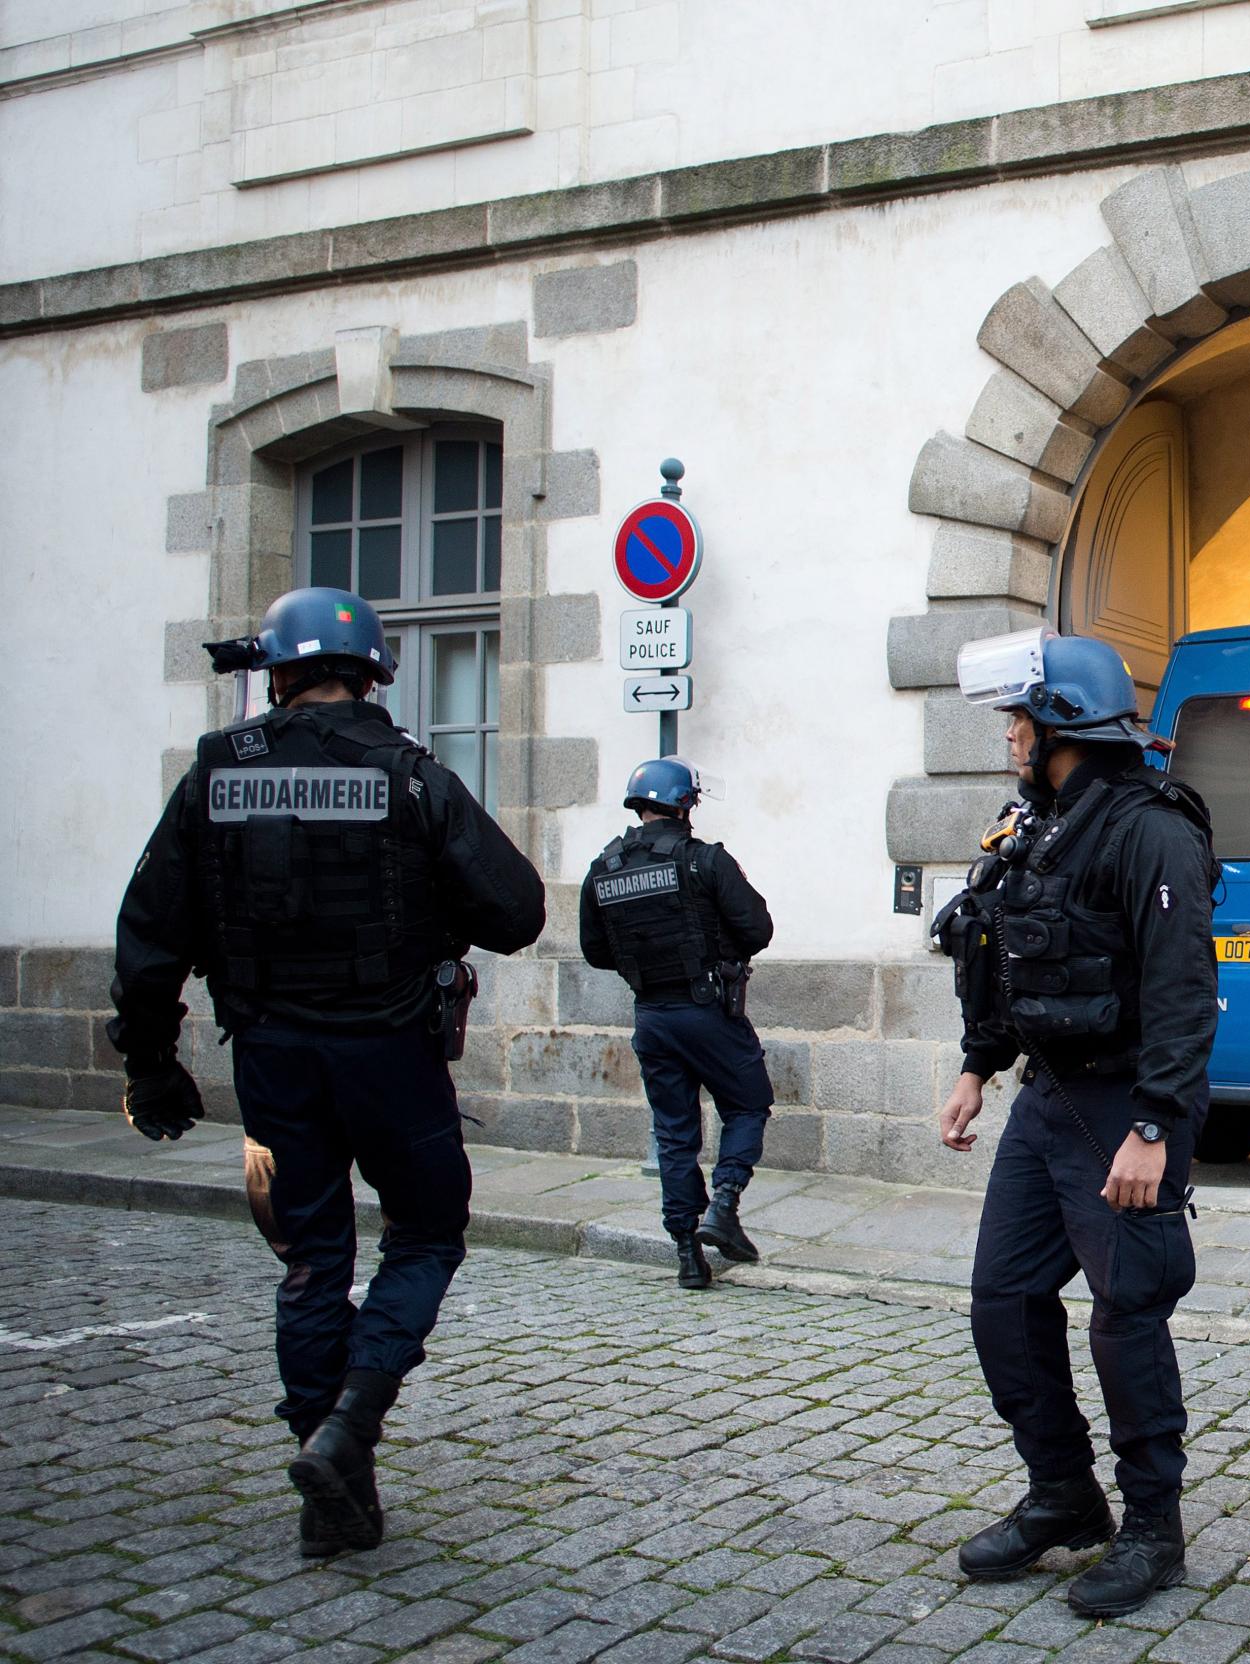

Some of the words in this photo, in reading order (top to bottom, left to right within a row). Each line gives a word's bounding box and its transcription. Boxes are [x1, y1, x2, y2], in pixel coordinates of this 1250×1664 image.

[636, 619, 671, 635] SAUF
[629, 642, 676, 659] POLICE
[211, 779, 386, 810] GENDARMERIE
[596, 867, 677, 900] GENDARMERIE
